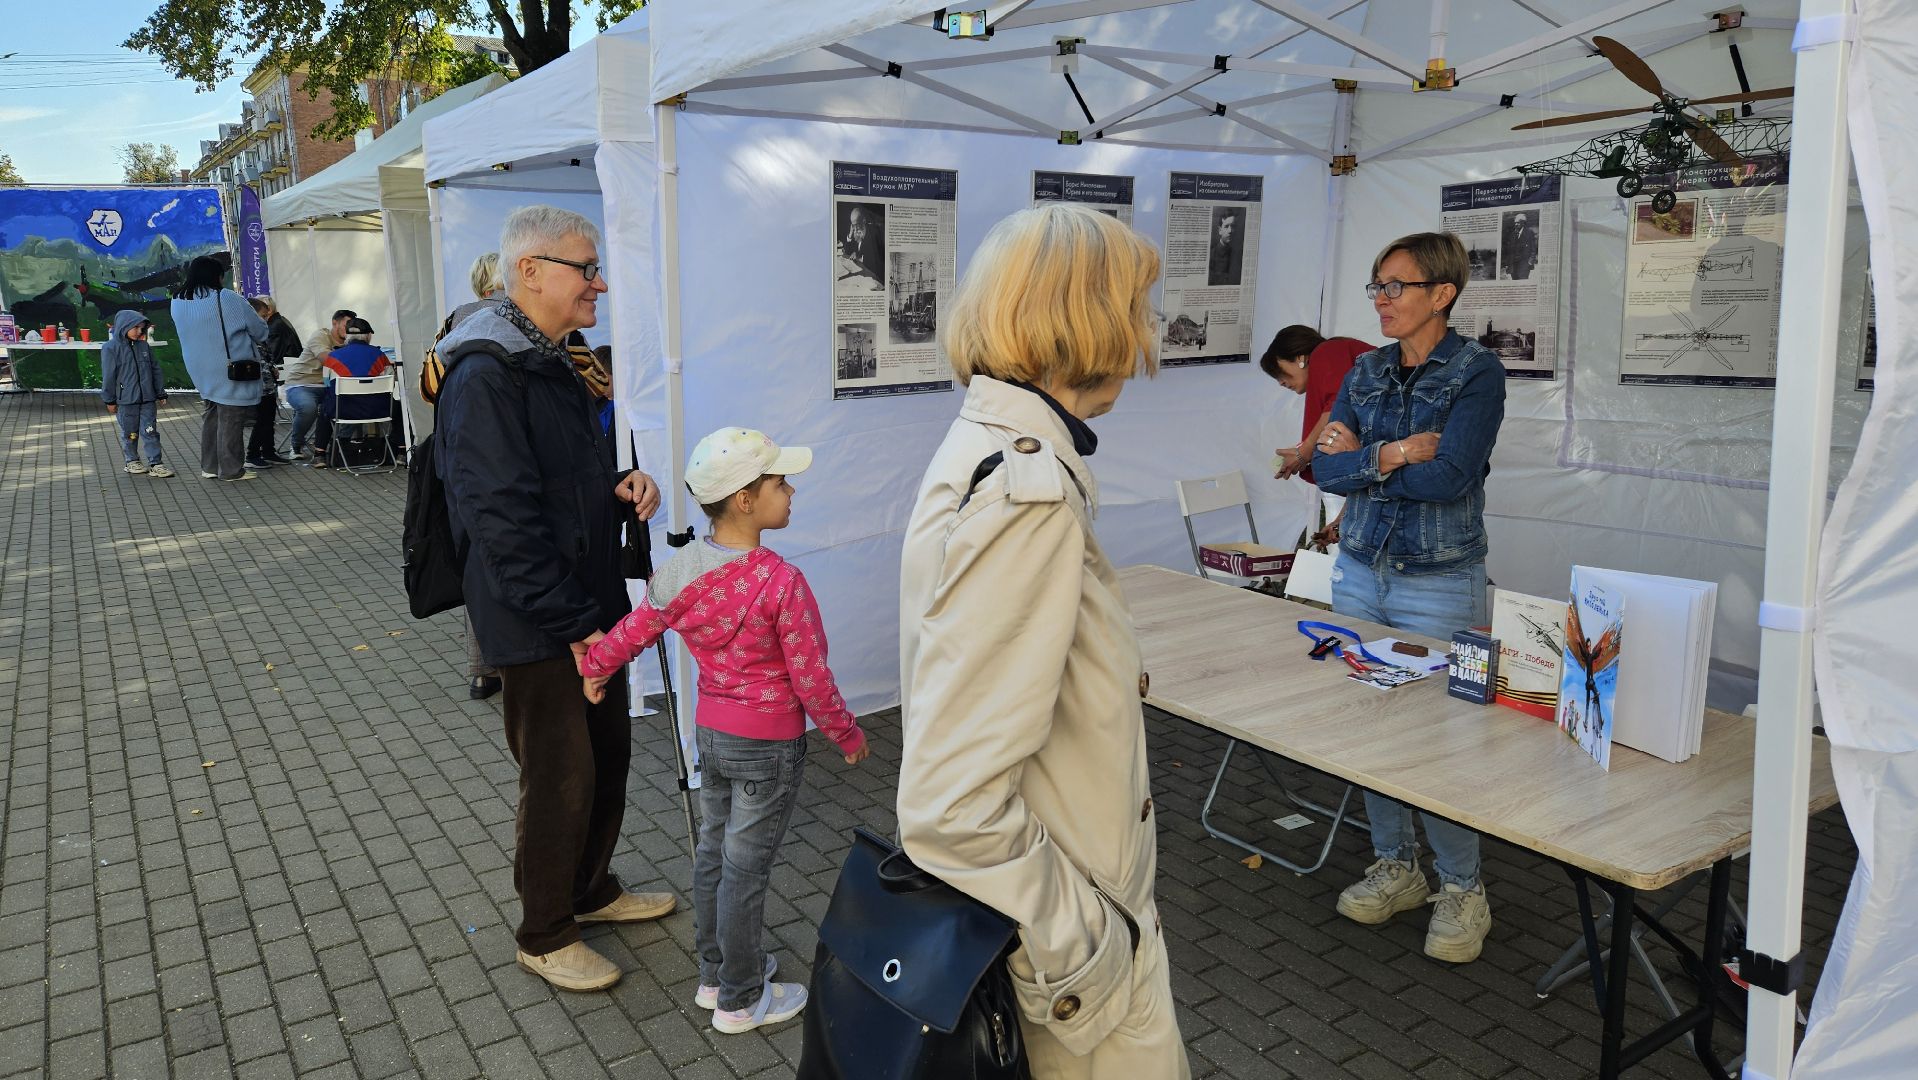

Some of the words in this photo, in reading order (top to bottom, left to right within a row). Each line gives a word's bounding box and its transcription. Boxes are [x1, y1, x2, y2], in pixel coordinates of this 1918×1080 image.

[1682, 166, 1739, 177] Конструкци
[872, 173, 939, 185] Воздухоплавательный
[1682, 176, 1717, 186] первого
[872, 183, 896, 191] кружок
[897, 183, 915, 191] МВТУ
[1065, 180, 1080, 189] Борис
[1499, 184, 1541, 194] опробоаие
[1525, 653, 1555, 669] Победе
